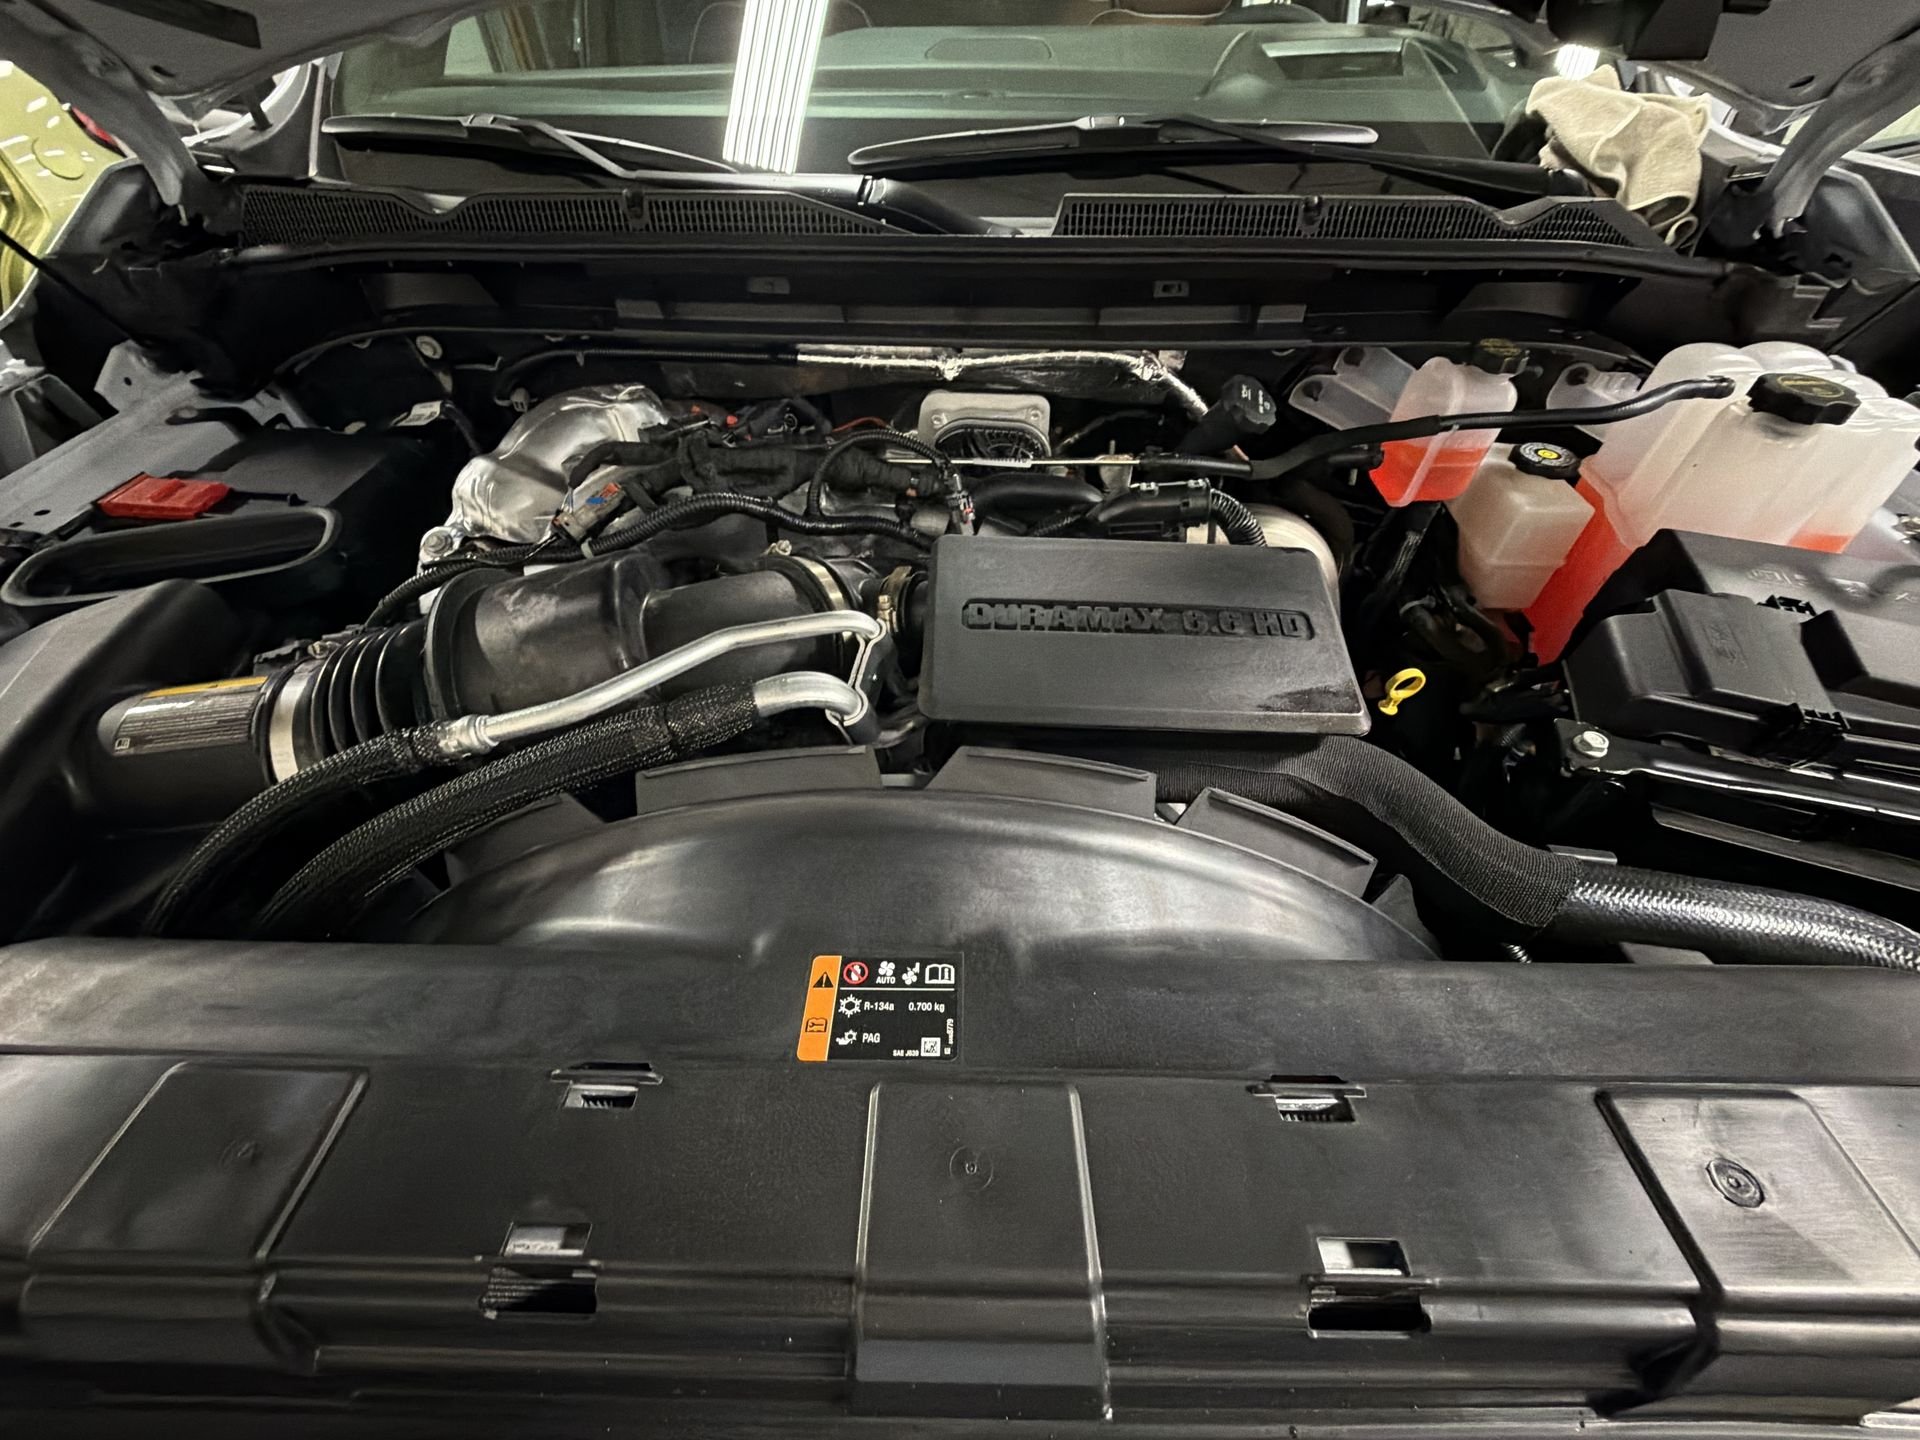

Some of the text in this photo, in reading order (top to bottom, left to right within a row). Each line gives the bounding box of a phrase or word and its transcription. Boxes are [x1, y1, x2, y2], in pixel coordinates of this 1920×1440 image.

[966, 602, 1312, 638] DURAMAX 6.6 HD
[876, 976, 896, 984] AUTO
[863, 1001, 946, 1013] R-134a 0.700 kg
[862, 1033, 881, 1043] PAG
